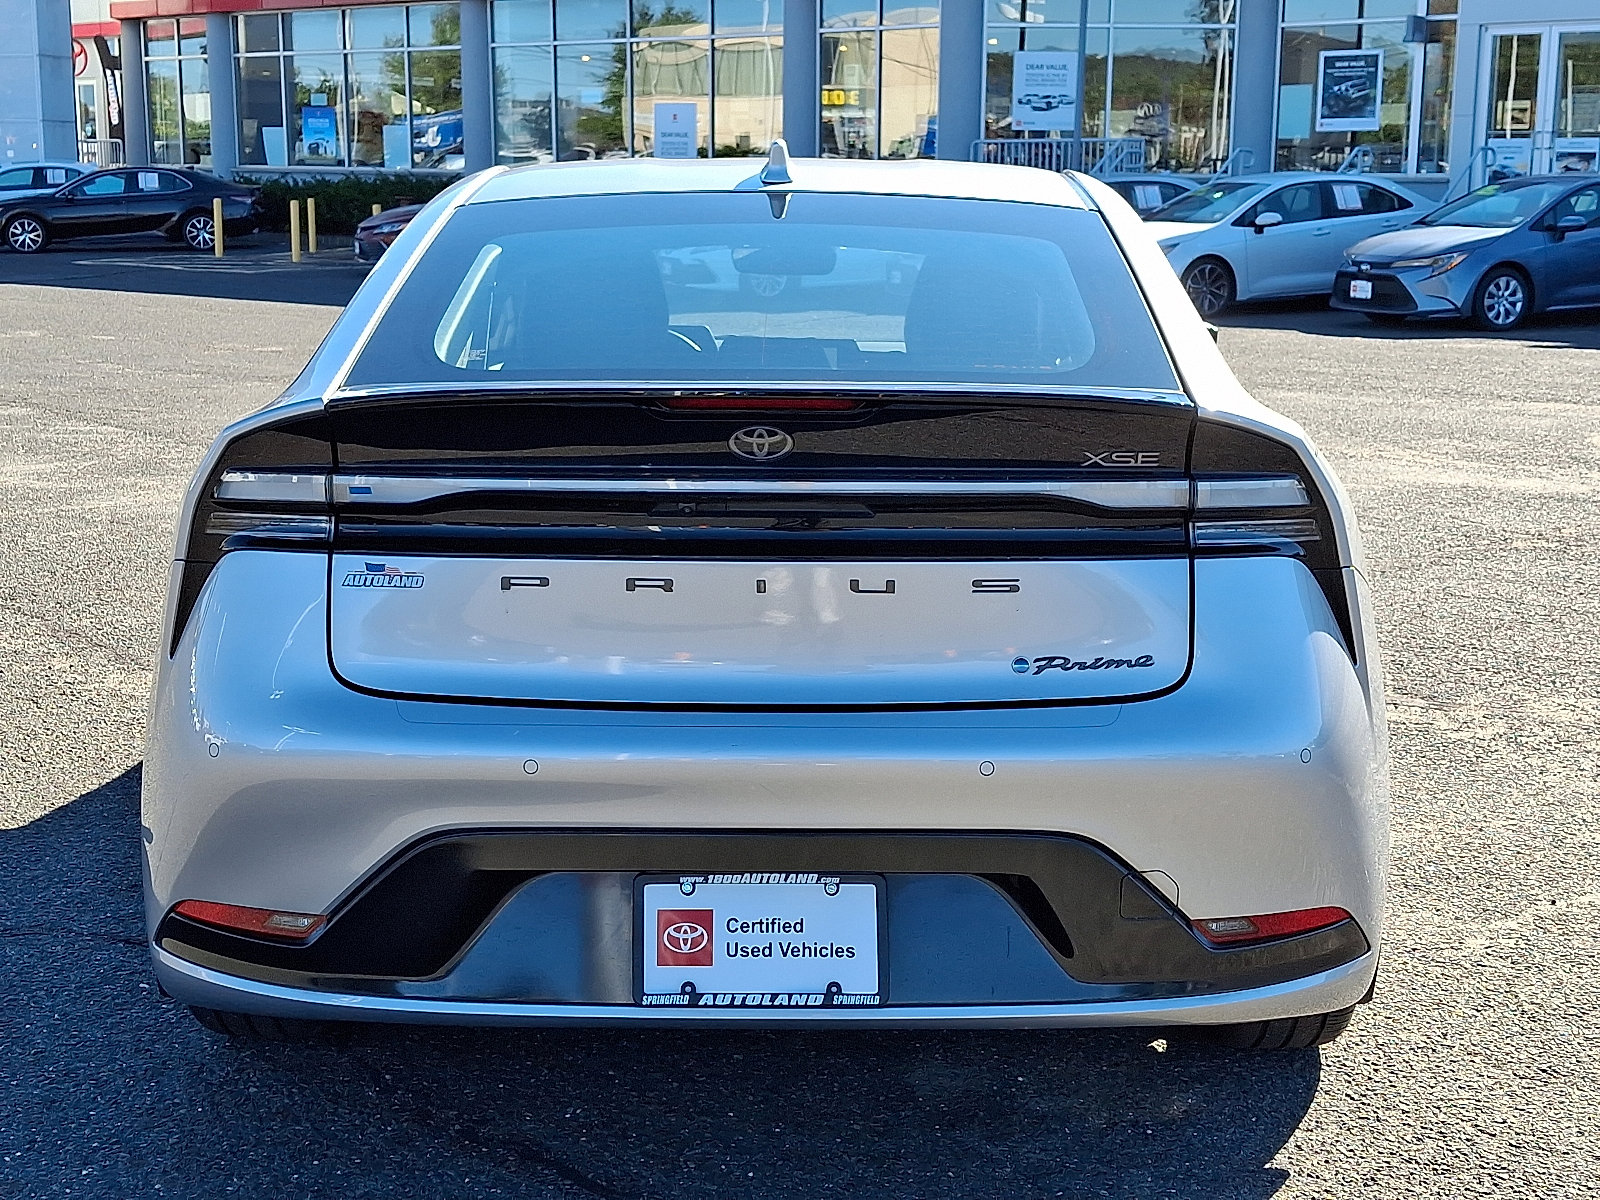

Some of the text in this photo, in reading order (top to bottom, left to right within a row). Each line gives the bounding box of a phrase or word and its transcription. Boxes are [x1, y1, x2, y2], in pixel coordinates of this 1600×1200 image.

[1080, 451, 1161, 467] XSE
[342, 573, 424, 588] AUTOLAND
[501, 576, 1021, 594] PRIUS
[1032, 654, 1155, 676] Prime
[679, 873, 840, 884] www.1800AUTOLAND.com
[726, 917, 804, 934] Certified
[726, 941, 856, 959] Used Vehicles
[642, 994, 880, 1006] SPRINGFIELD AUTOLAND SPRINGFIELD
